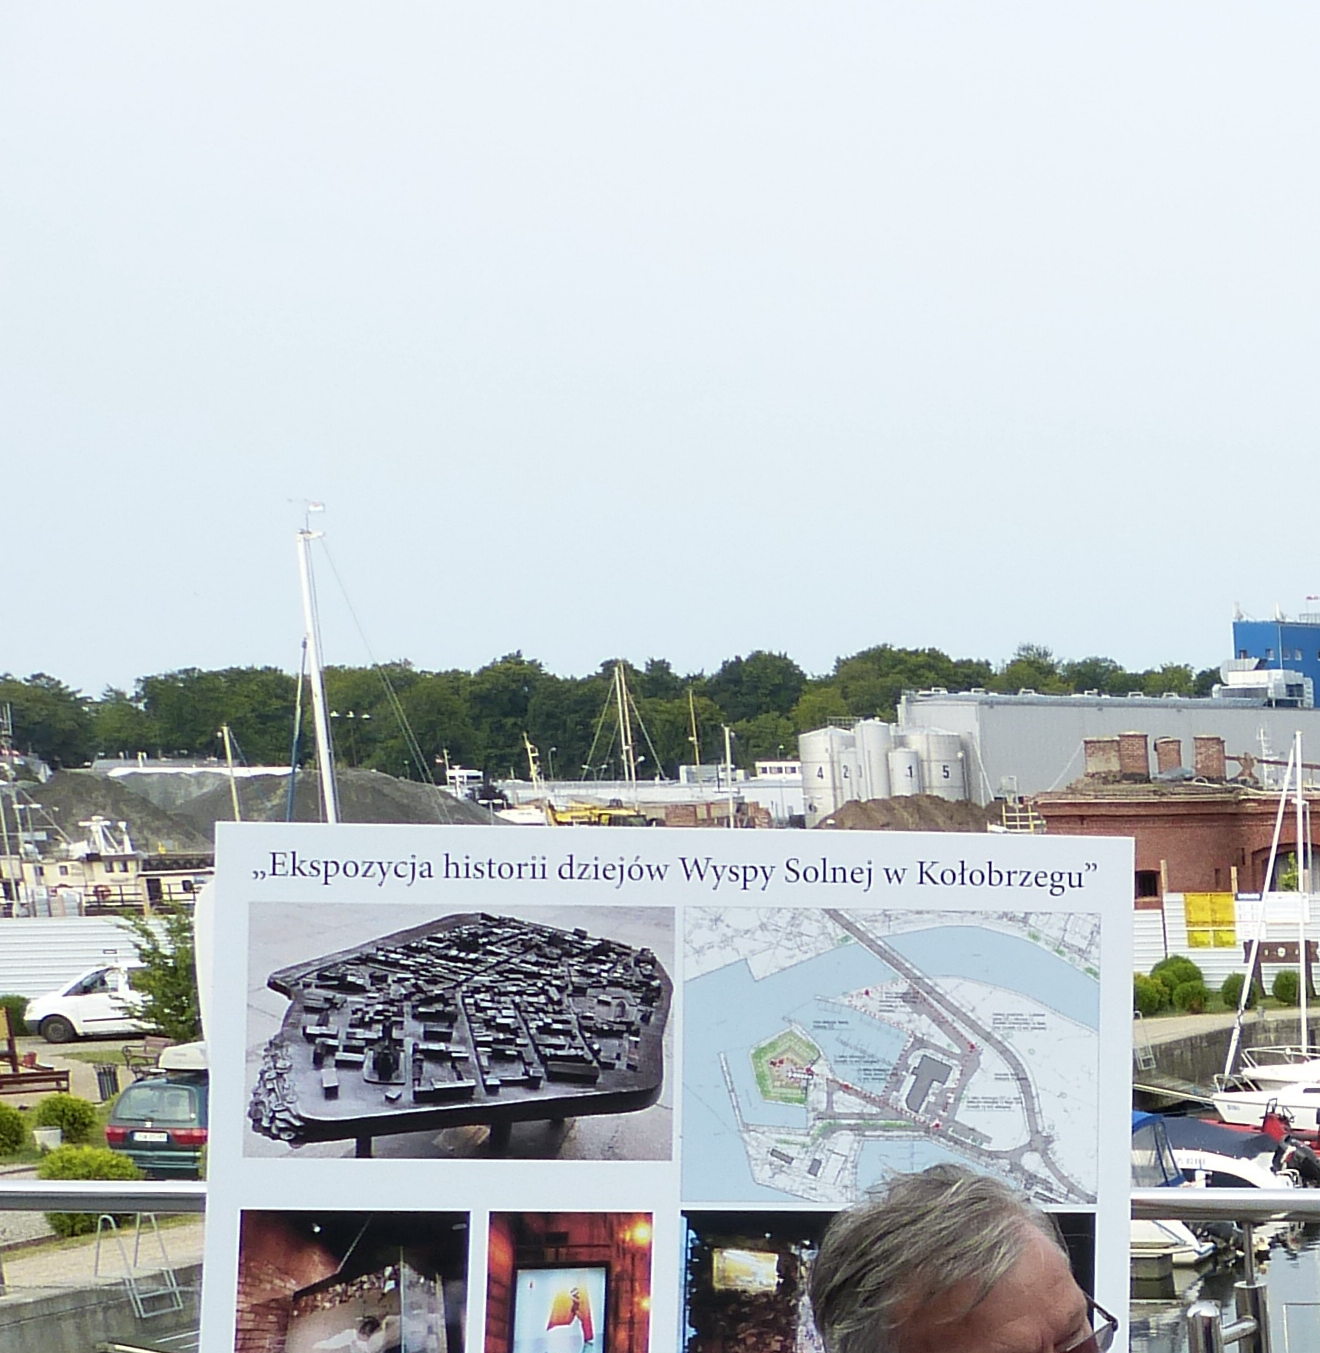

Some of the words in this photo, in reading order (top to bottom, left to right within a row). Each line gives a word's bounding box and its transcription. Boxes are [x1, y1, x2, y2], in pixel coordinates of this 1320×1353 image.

[252, 851, 434, 887] „Ekspozycja
[443, 853, 548, 881] historii
[557, 854, 670, 889] dziejów
[678, 856, 776, 891] Wyspy
[785, 857, 873, 892] Solnej
[884, 867, 908, 885] w
[917, 860, 1098, 897] Kołobrzegu”
